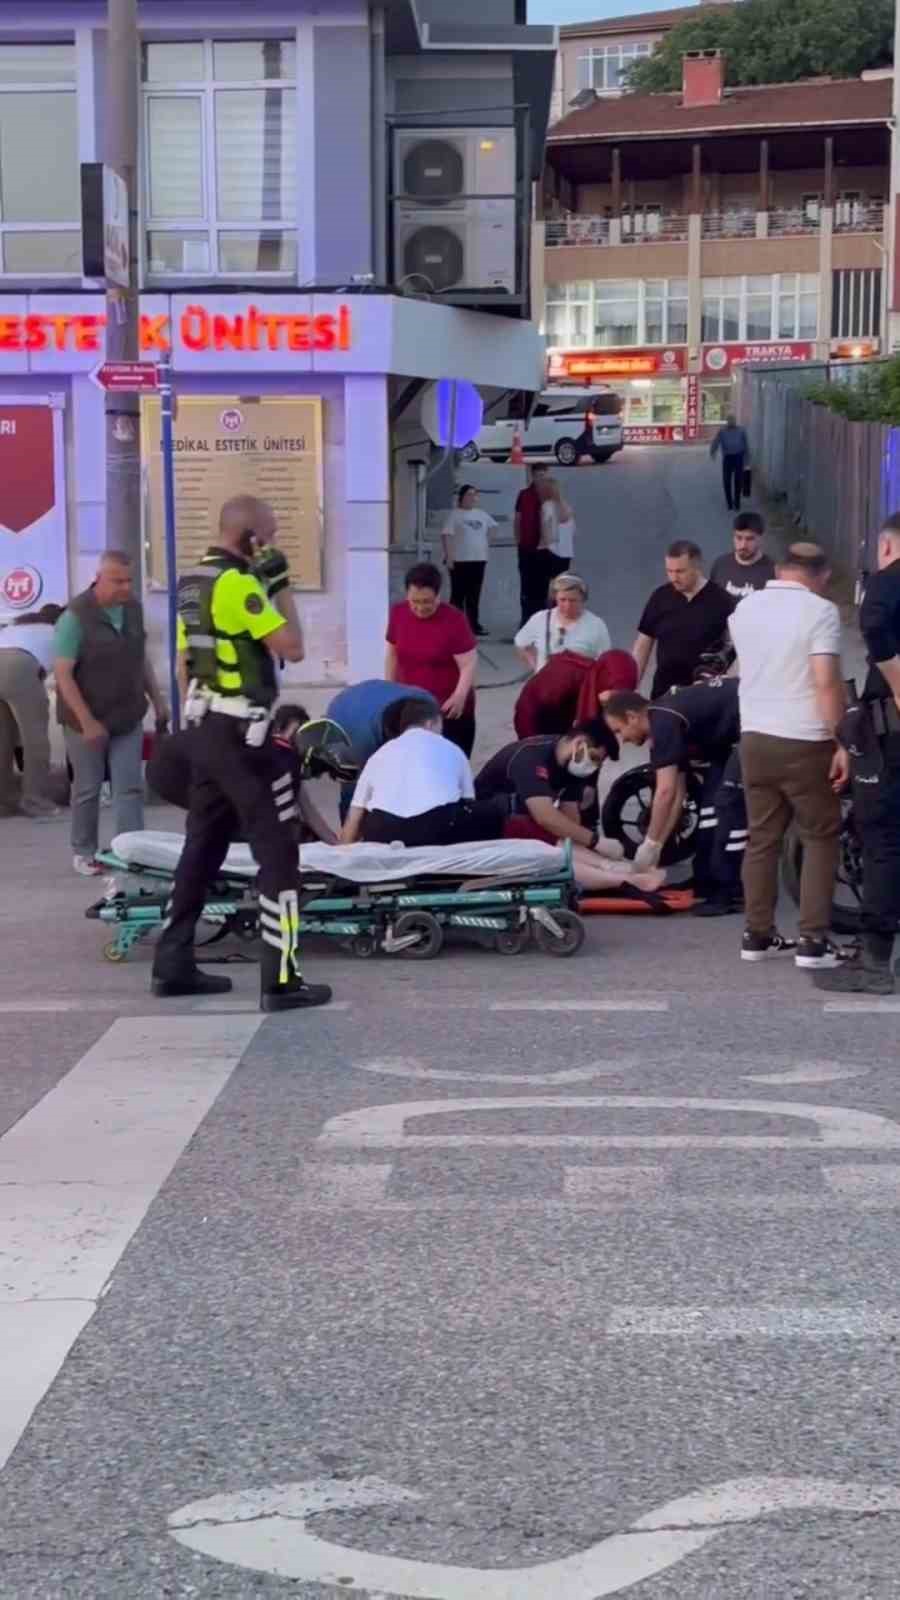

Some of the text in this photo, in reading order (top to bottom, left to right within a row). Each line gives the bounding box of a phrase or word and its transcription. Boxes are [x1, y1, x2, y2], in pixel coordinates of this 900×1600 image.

[0, 303, 350, 351] ESTEK ÜNİTESİ
[744, 345, 792, 357] TRAKYA
[160, 434, 306, 451] EDİKAL ESTETİK ÜNİTESİ
